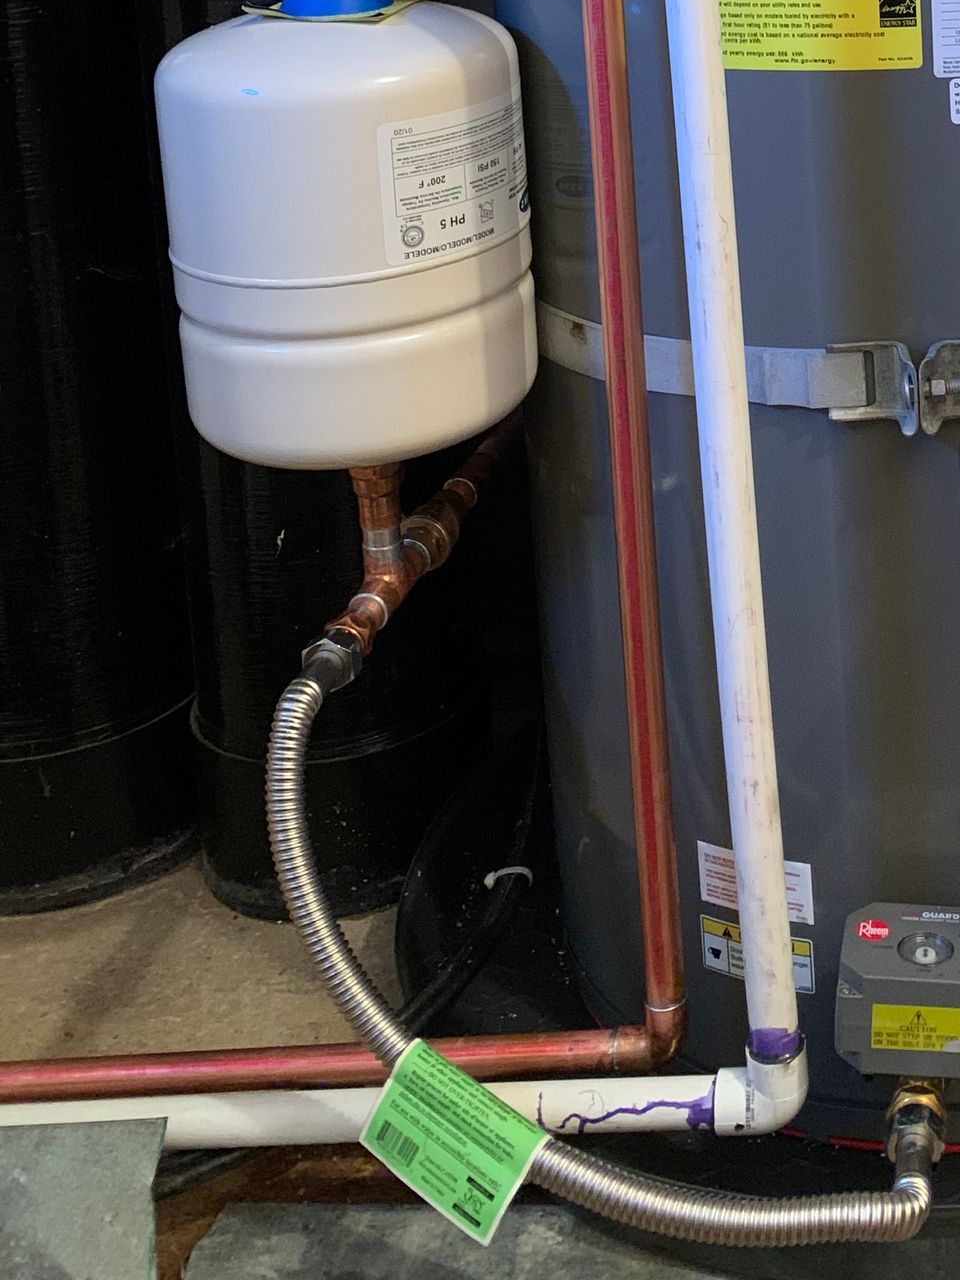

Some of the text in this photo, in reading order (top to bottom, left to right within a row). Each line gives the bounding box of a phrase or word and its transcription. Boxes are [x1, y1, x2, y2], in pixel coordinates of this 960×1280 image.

[394, 127, 413, 137] 01/20
[477, 160, 489, 172] PSI
[440, 214, 466, 230] PH 5
[404, 227, 495, 259] MODEL/MODELO/MODELE
[859, 920, 888, 938] Rheem
